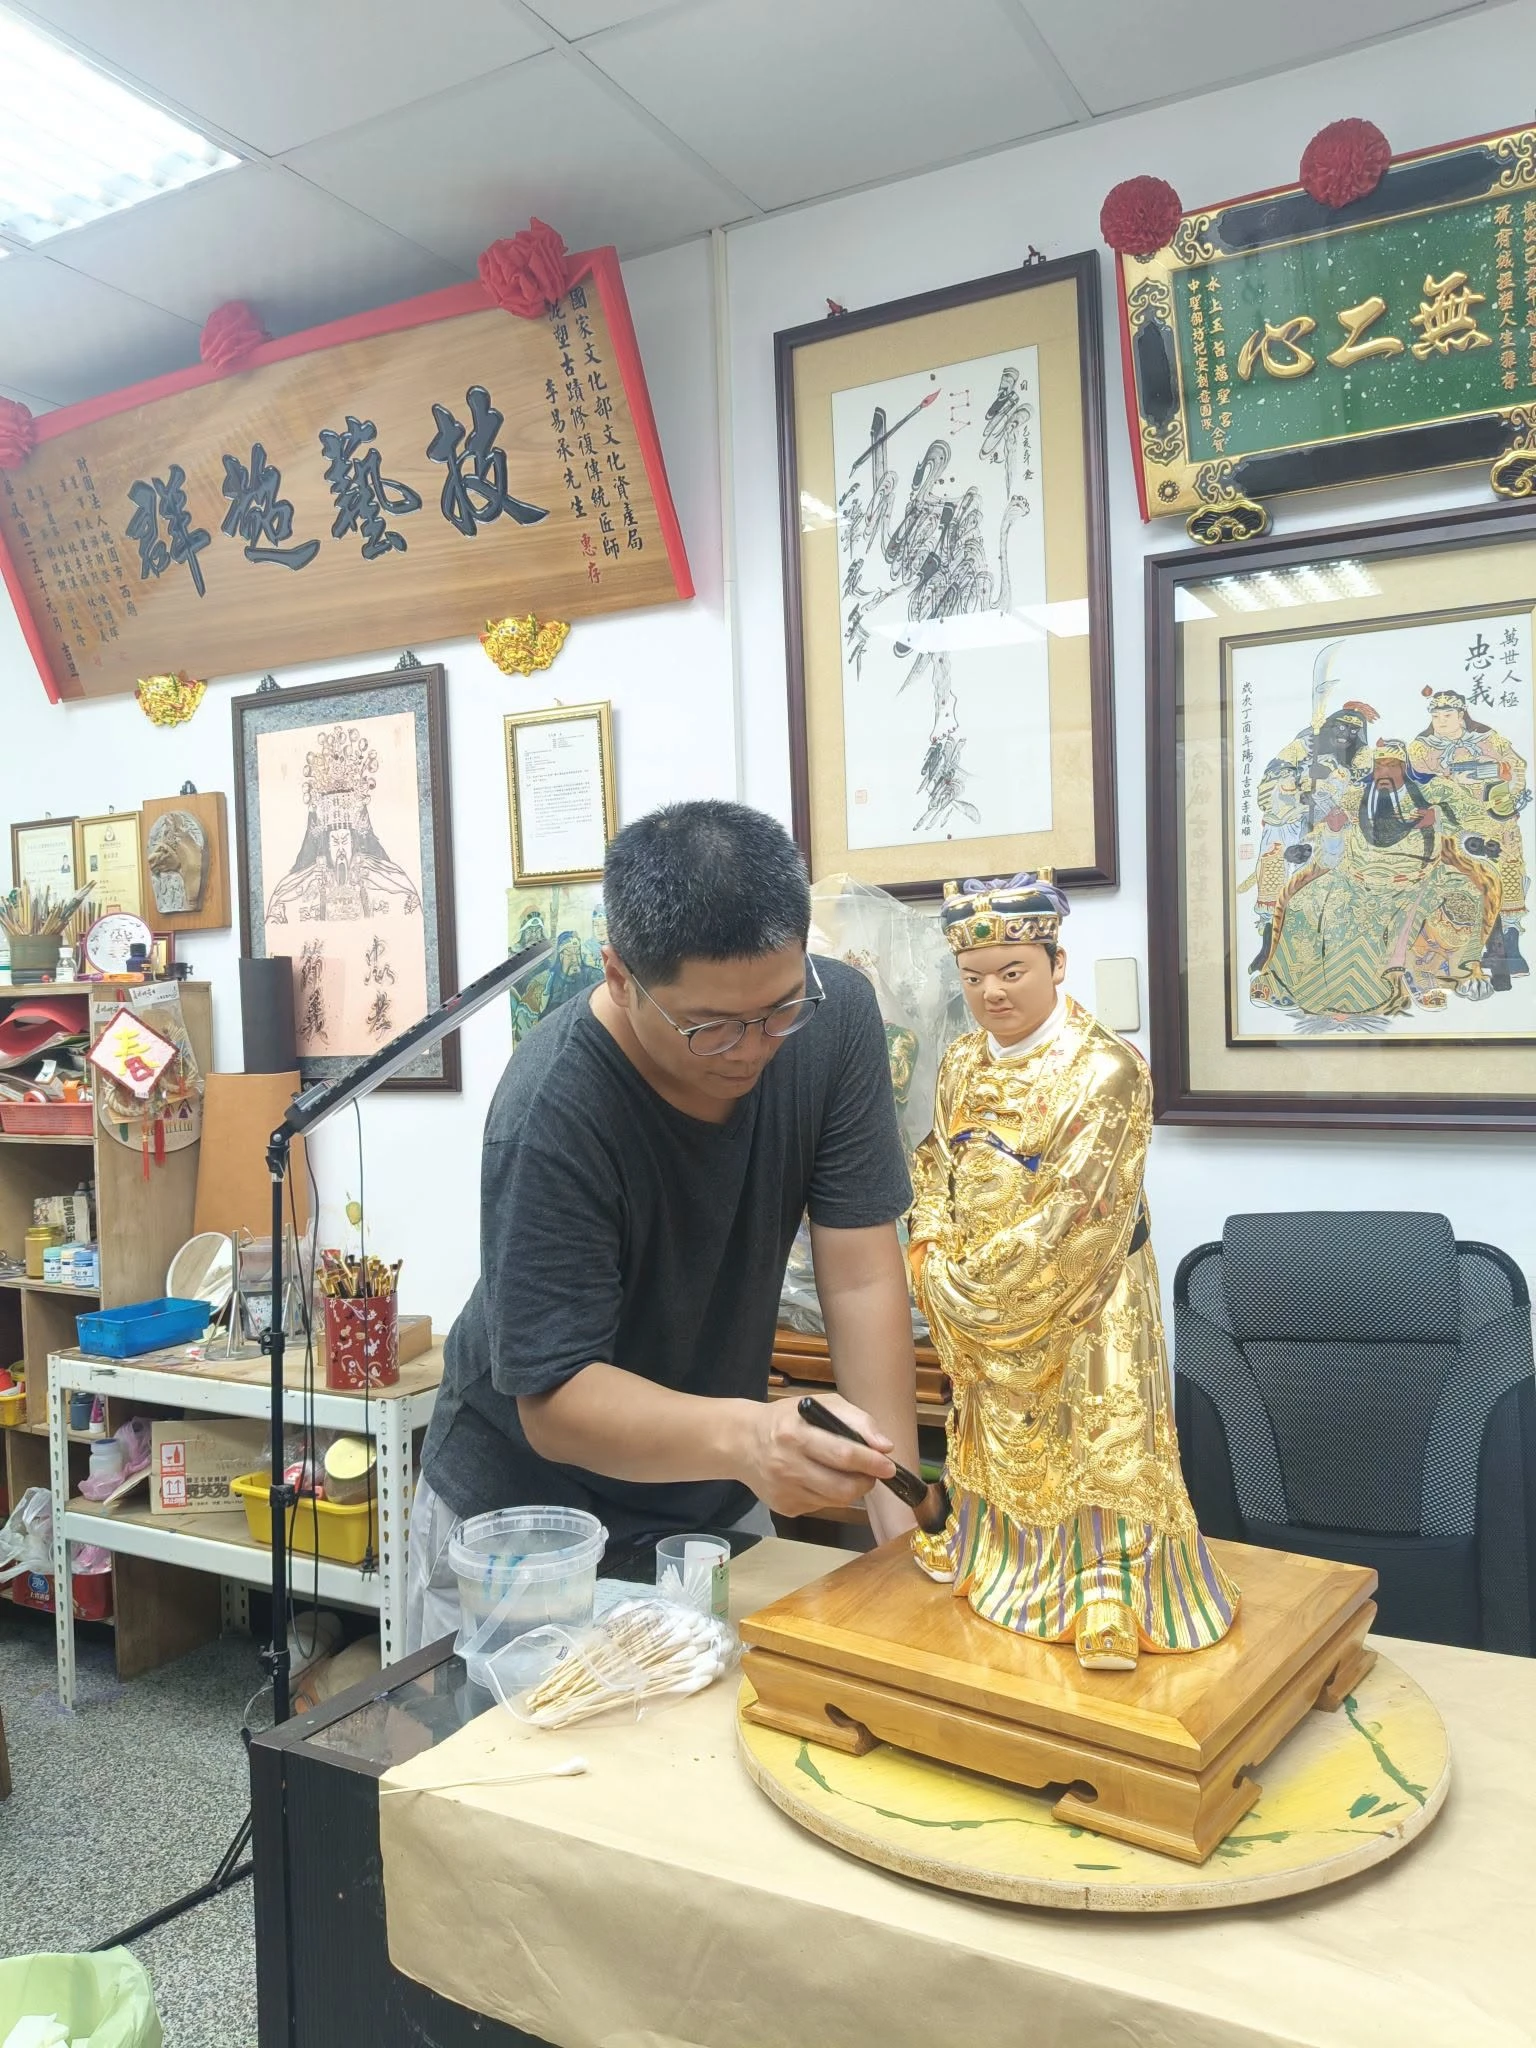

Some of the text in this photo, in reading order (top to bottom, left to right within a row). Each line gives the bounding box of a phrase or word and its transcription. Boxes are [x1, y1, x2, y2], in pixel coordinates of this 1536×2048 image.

[570, 286, 643, 551] 國家文化部文化資產局
[1465, 633, 1495, 708] 忠義
[1498, 627, 1522, 708] 萬世人極
[112, 1026, 160, 1082] 春
